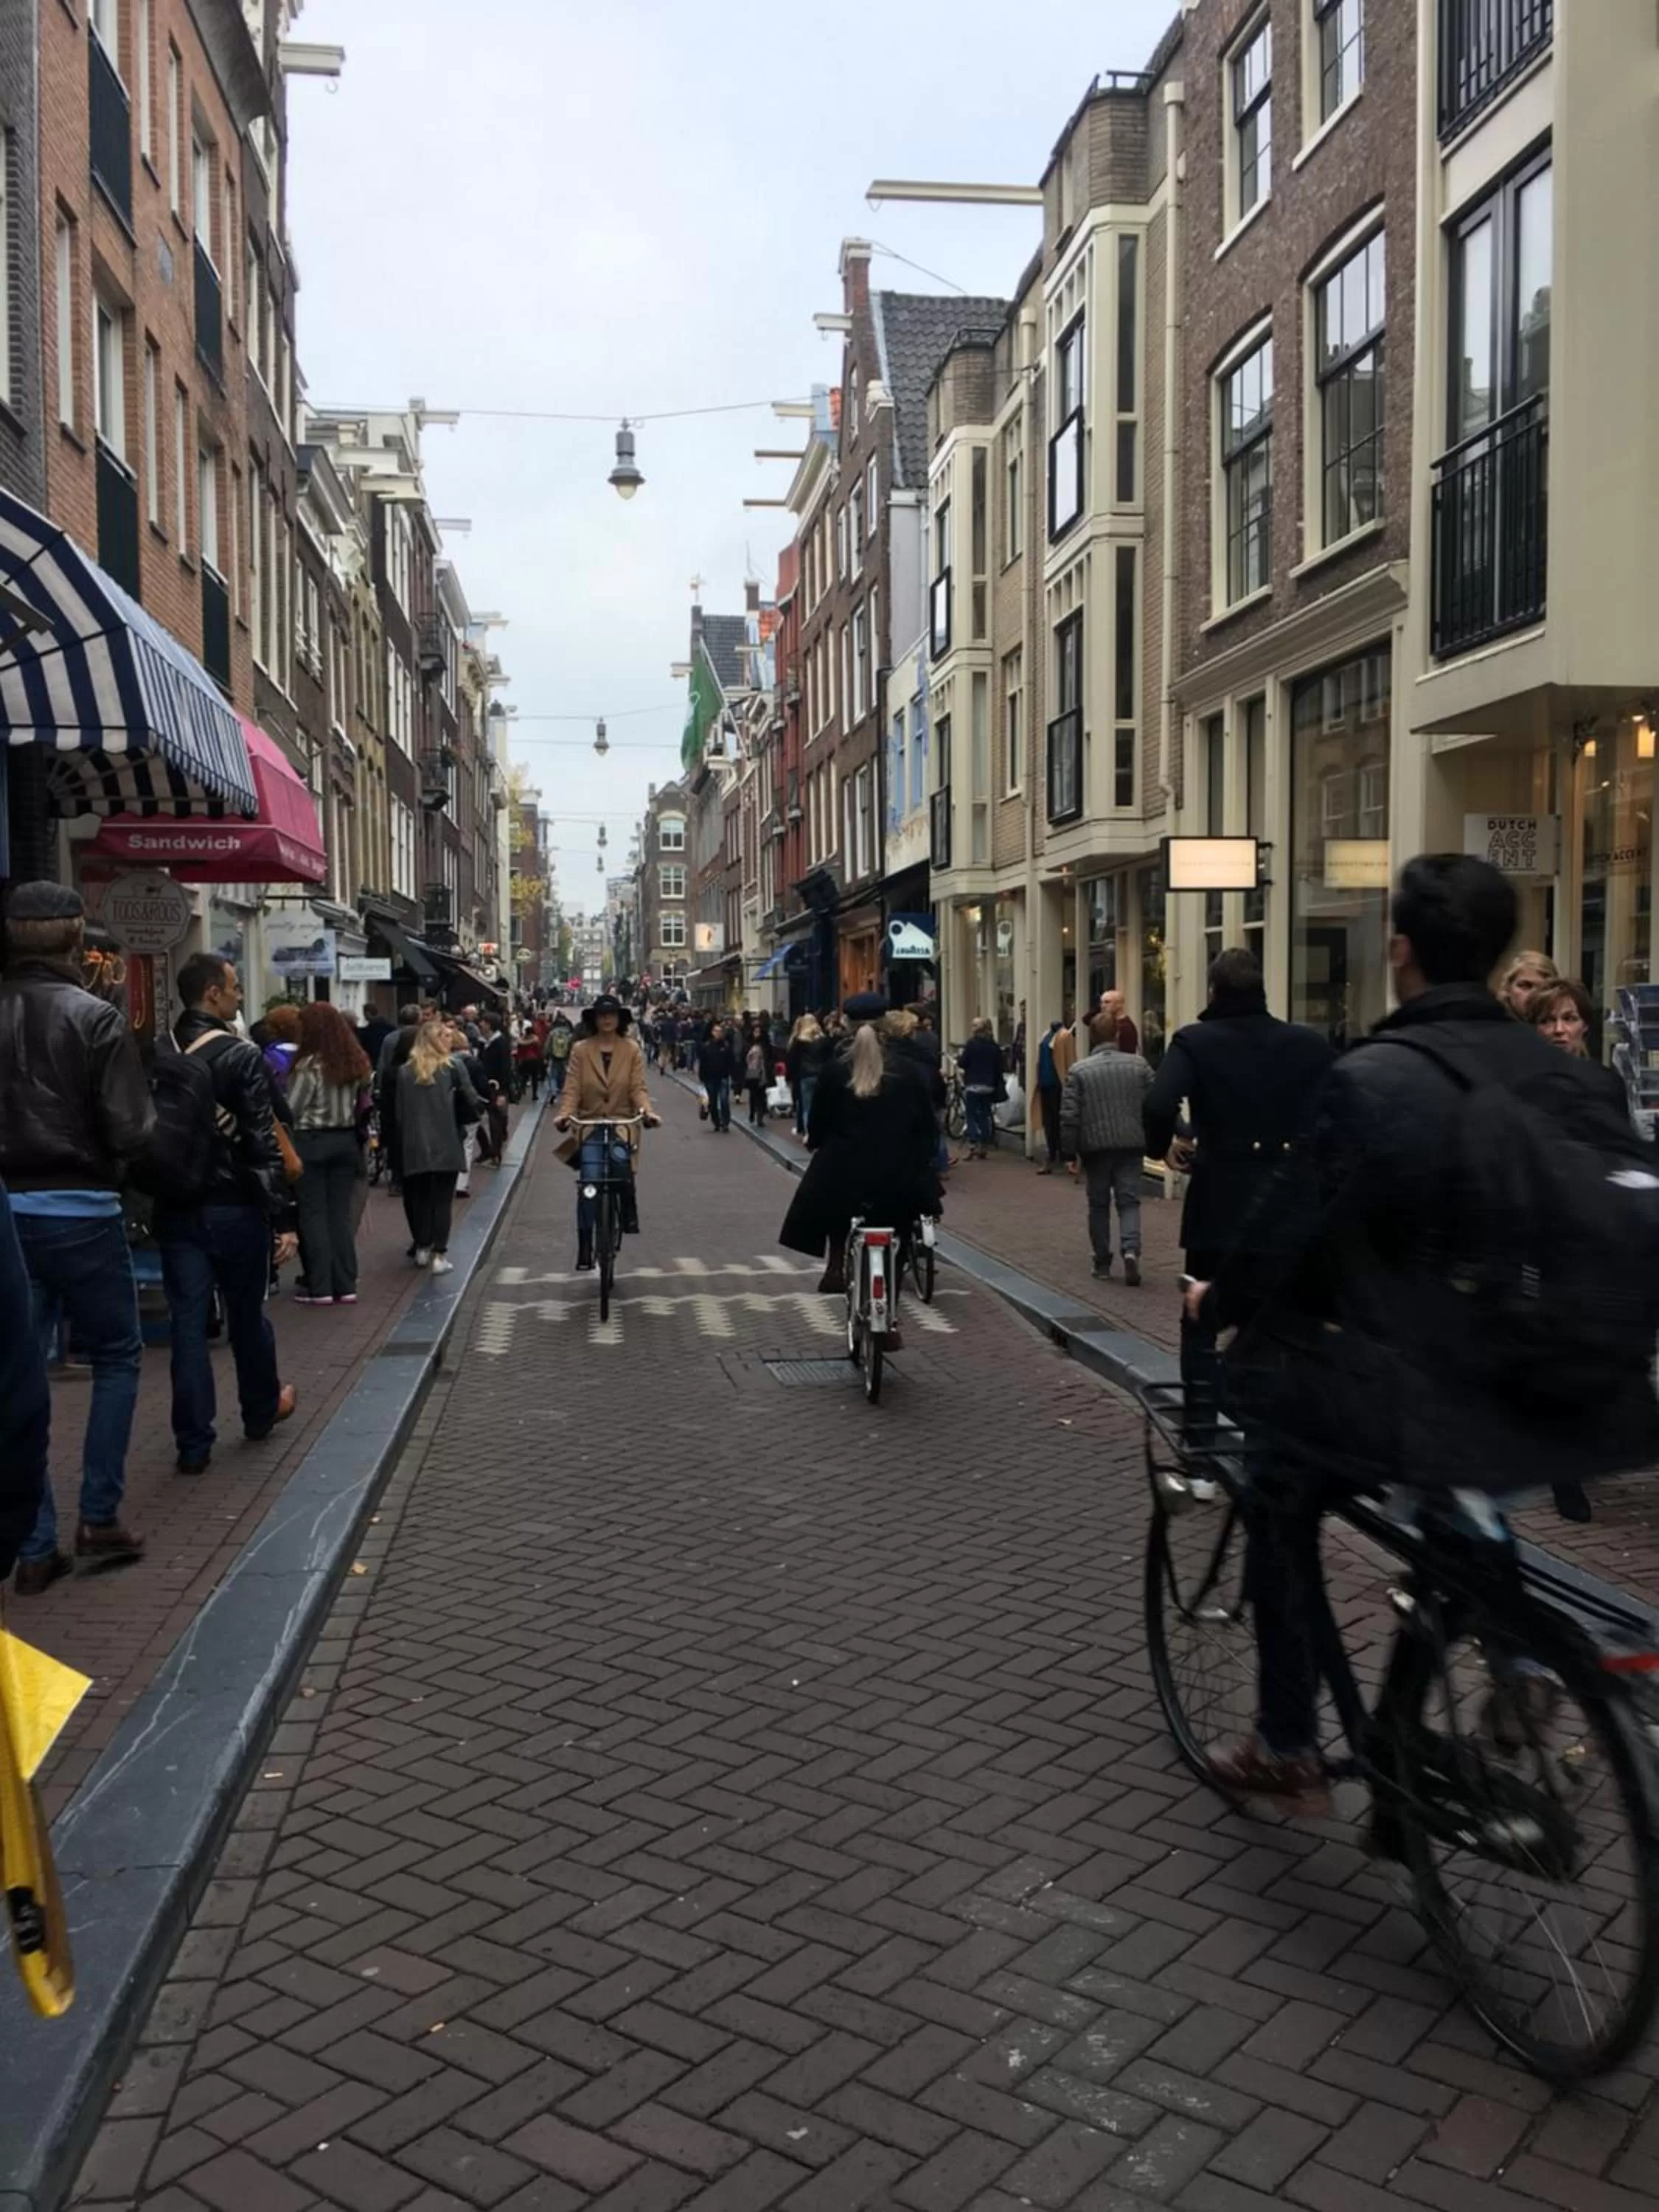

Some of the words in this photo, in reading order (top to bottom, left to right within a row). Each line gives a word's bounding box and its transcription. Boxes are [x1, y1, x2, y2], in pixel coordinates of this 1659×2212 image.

[1488, 820, 1537, 831] DUTCH
[128, 833, 241, 850] Sandwich
[1488, 830, 1537, 849] ACC
